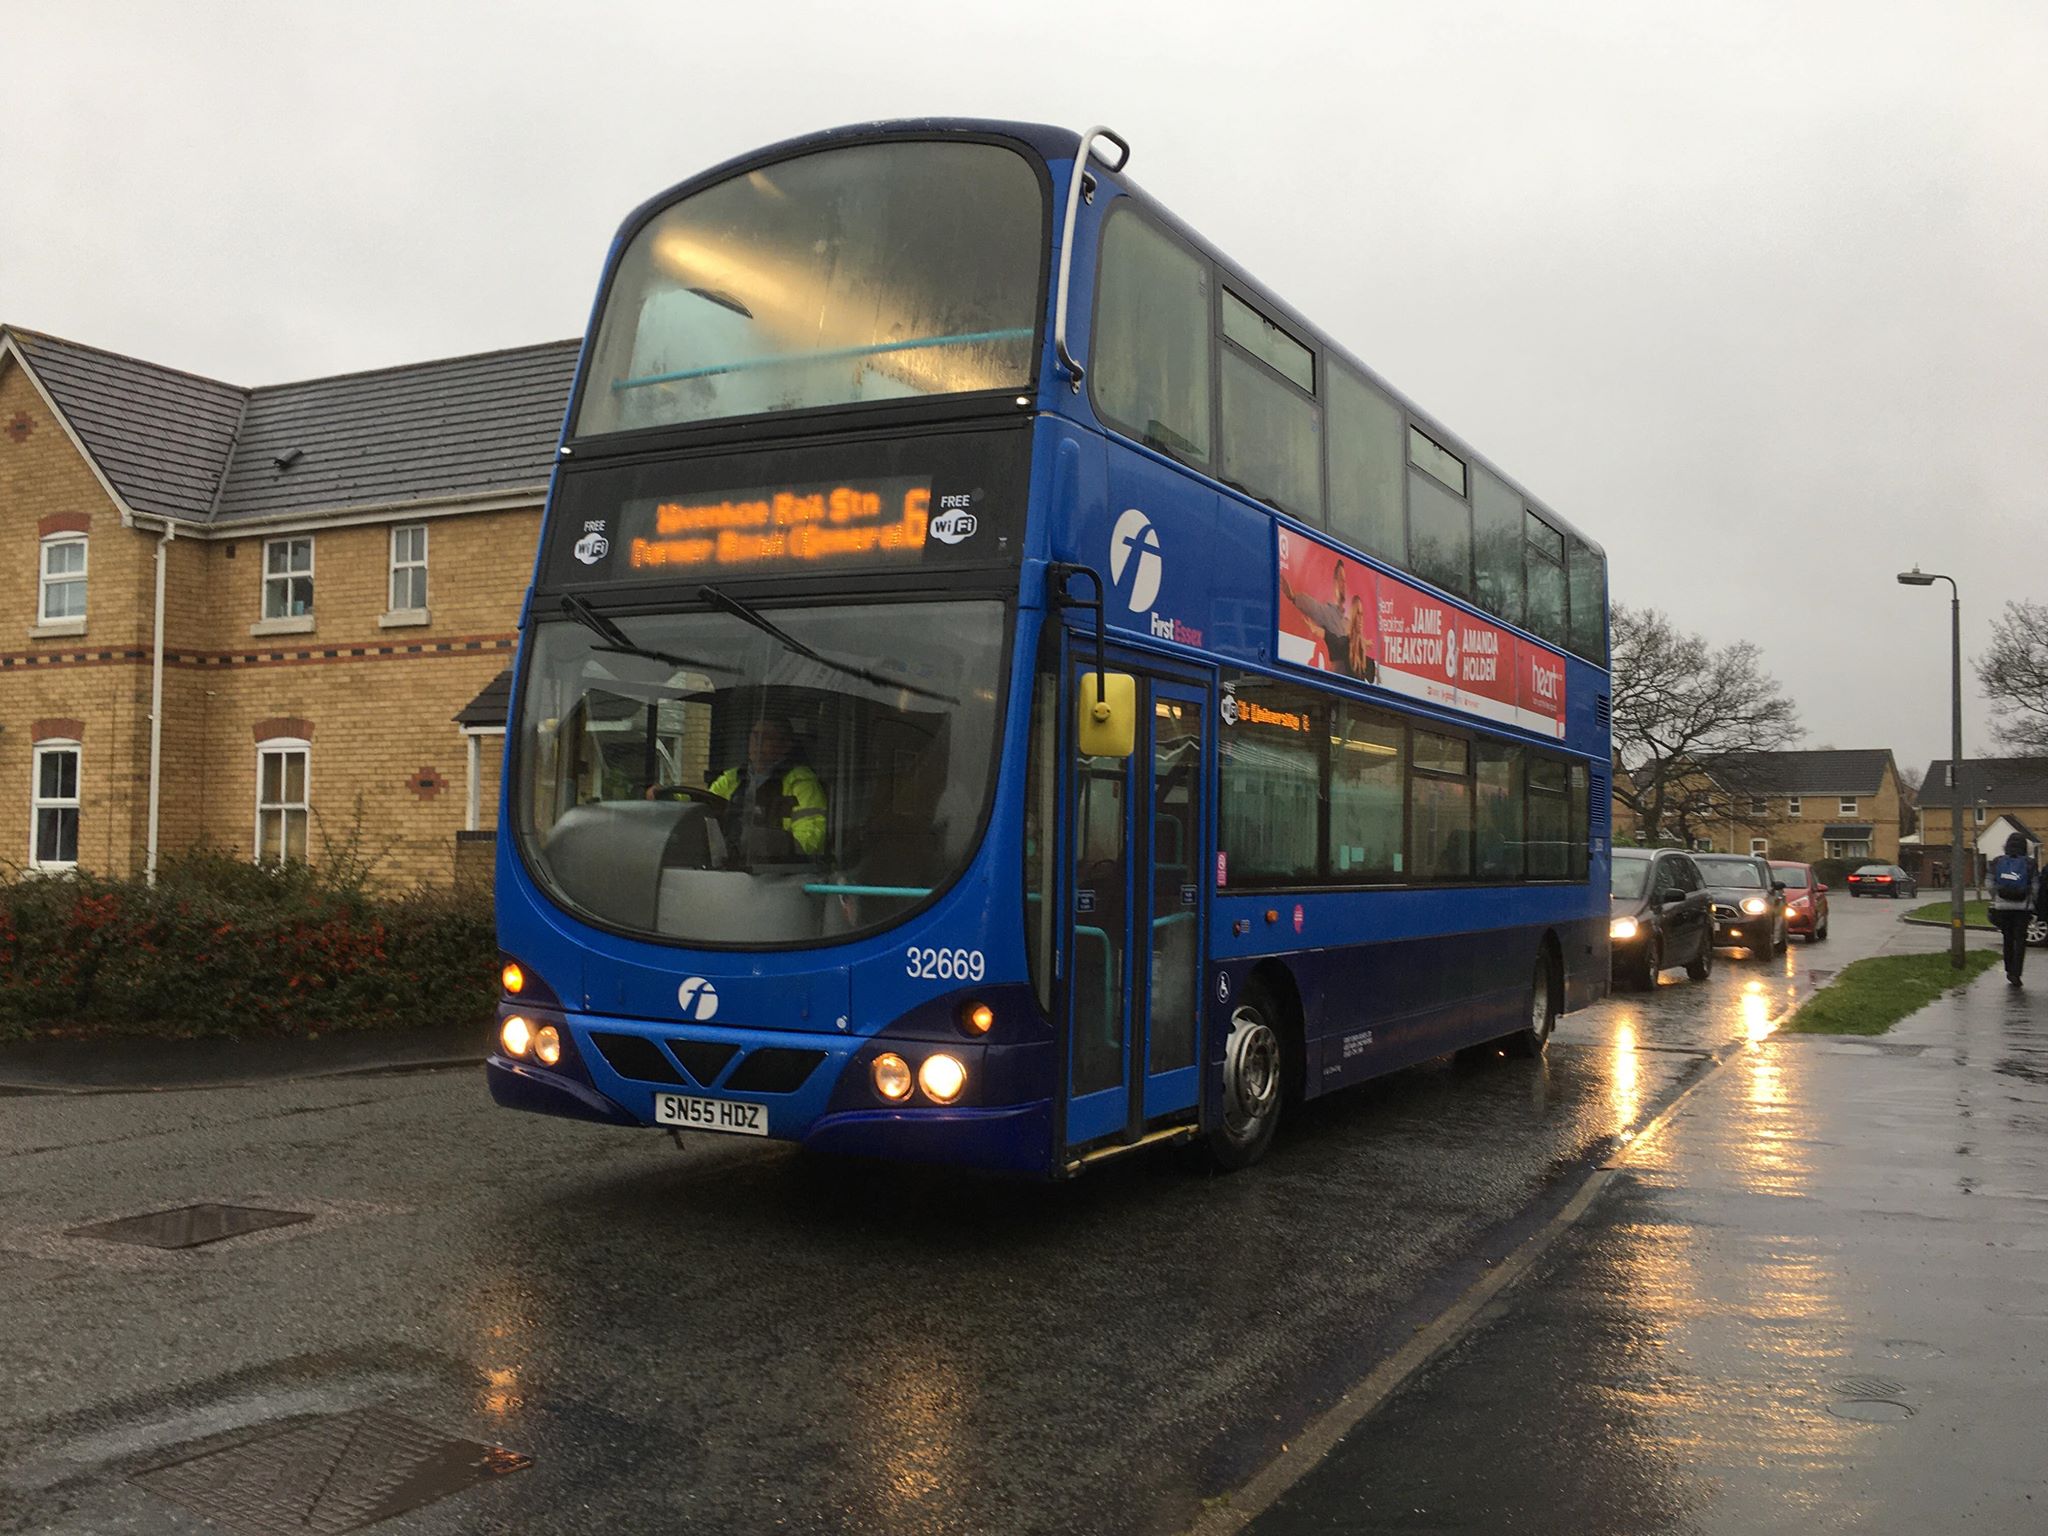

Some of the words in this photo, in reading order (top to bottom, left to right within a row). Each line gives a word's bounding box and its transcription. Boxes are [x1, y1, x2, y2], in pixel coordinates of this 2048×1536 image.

[941, 495, 970, 507] FREE
[584, 520, 605, 532] FREE
[1151, 611, 1174, 641] First
[1174, 619, 1202, 648] Essex
[1411, 607, 1442, 635] JAMIE
[1384, 635, 1443, 665] THEAKSTON
[1462, 628, 1499, 655] AMANDA
[1462, 656, 1497, 682] HOLDEN
[1531, 655, 1558, 701] heart
[906, 946, 985, 982] 32669
[664, 1097, 715, 1123] SN55
[721, 1102, 760, 1129] HDZ
